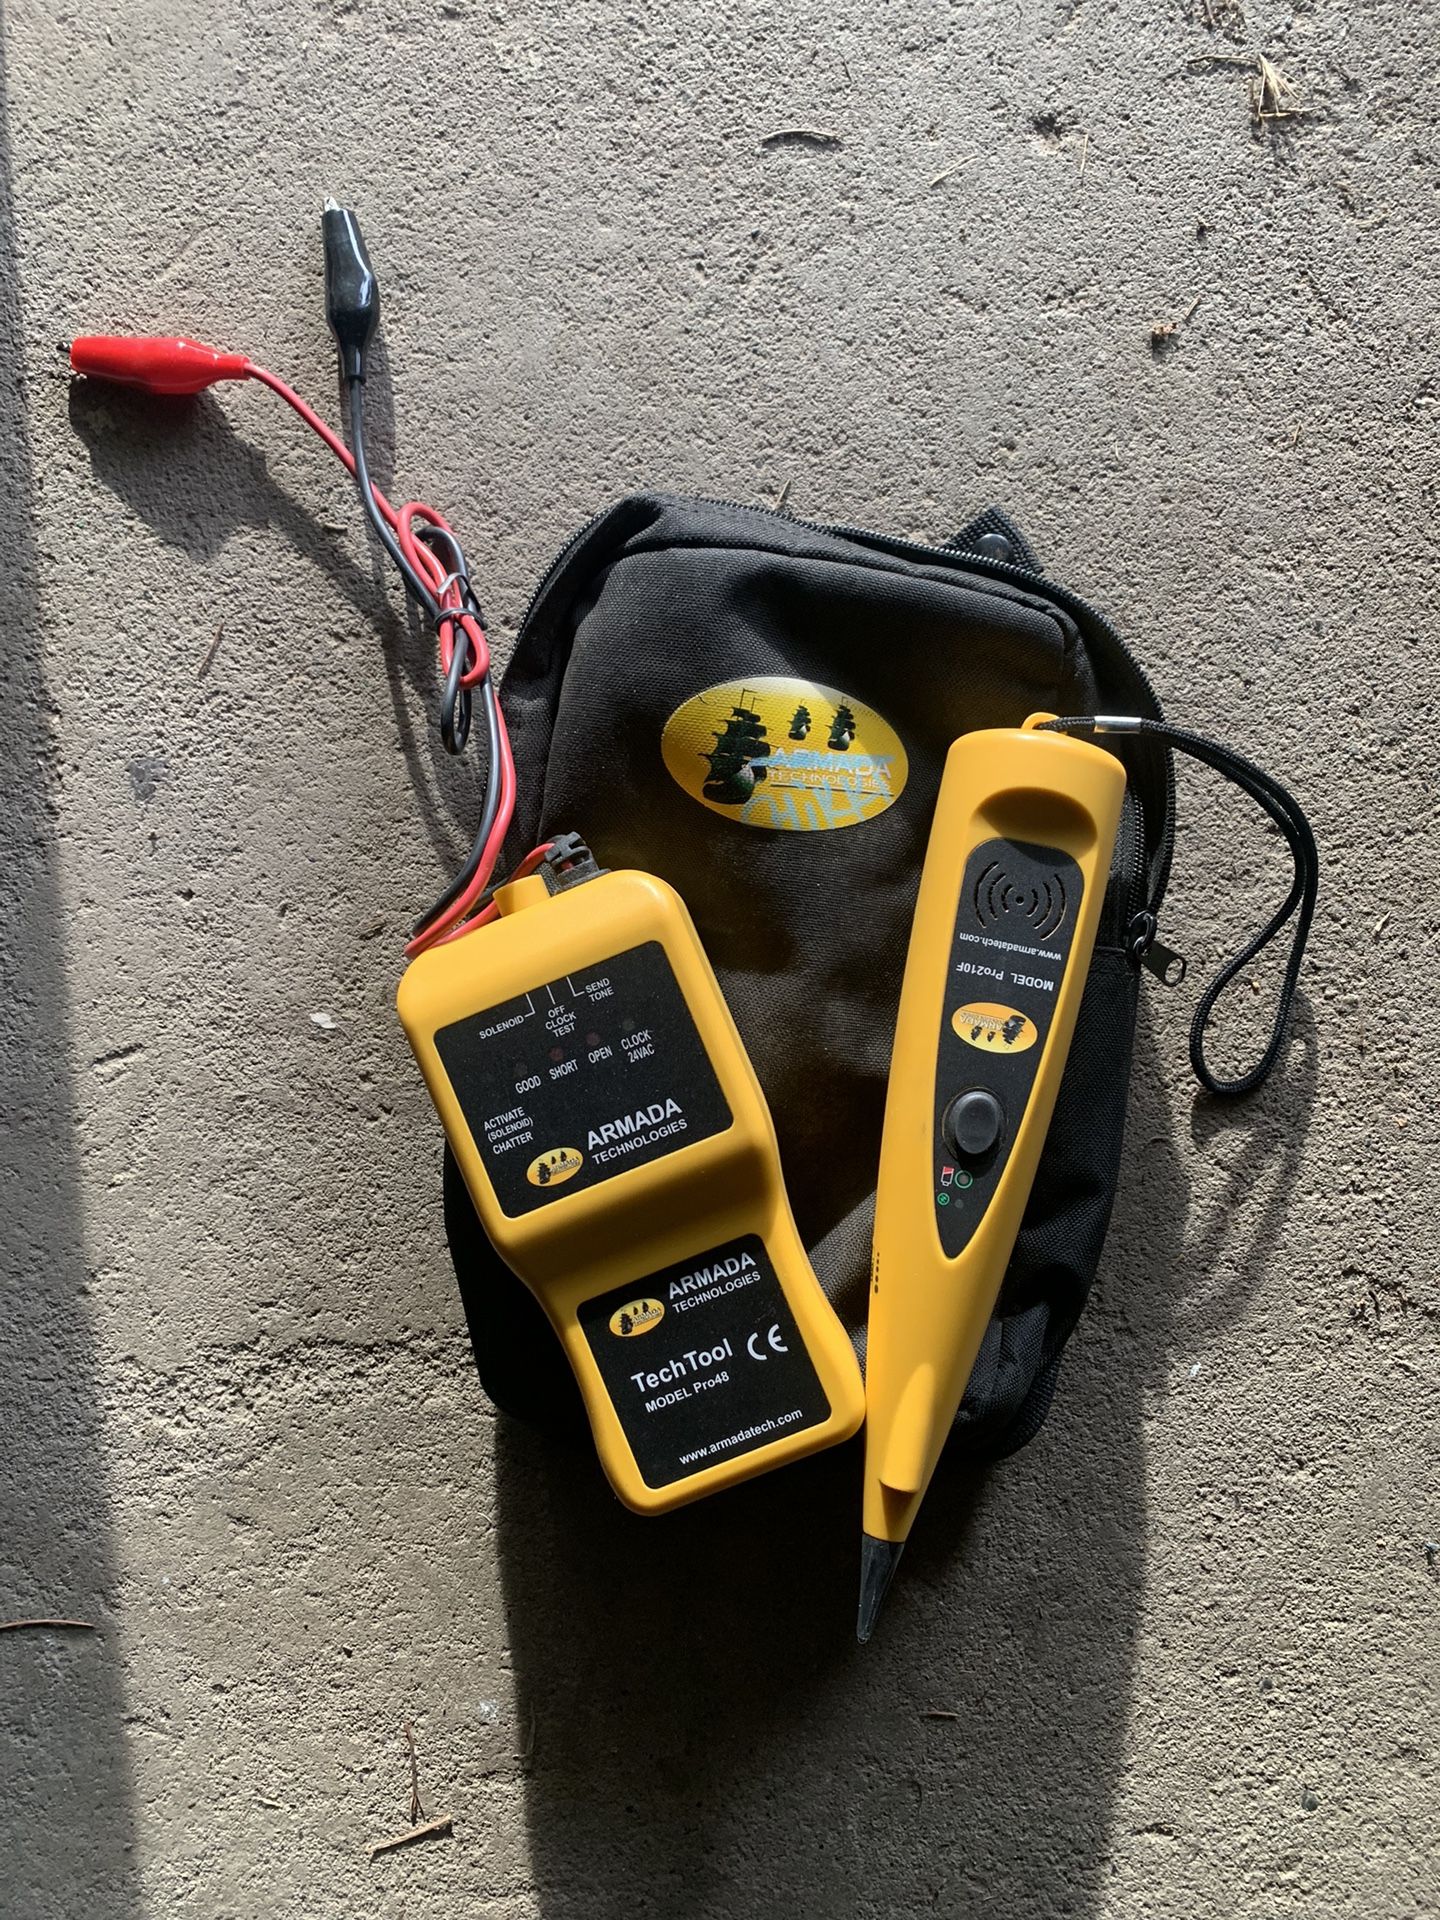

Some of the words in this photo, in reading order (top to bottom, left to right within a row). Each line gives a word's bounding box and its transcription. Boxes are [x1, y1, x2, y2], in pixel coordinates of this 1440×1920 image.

[959, 932, 1062, 960] www.armadatech.com
[956, 961, 1004, 980] Pro210F
[1010, 972, 1054, 991] MODEL
[585, 977, 611, 994] SEND
[588, 986, 615, 1002] TONE
[545, 1011, 577, 1030] CLOCK
[548, 1004, 566, 1018] OFF
[479, 1015, 524, 1040] SOLENOID
[552, 1022, 576, 1037] TEST
[515, 1075, 542, 1094] GOOD
[549, 1059, 579, 1081] SHORT
[588, 1045, 613, 1064] OPEN
[621, 1029, 652, 1050] CLOCK
[627, 1043, 655, 1063] 24VAC
[484, 1106, 525, 1131] ACTIVATE
[487, 1117, 534, 1143] (SOLENOID)
[587, 1098, 683, 1151] ARMADA
[492, 1131, 533, 1155] CHATTER
[592, 1118, 688, 1165] TECHNOLOGIES
[668, 1252, 757, 1299] ARMADA
[672, 1271, 761, 1314] TECHNOLOGIES
[630, 1337, 733, 1393] TechTool
[645, 1387, 692, 1413] MODEL
[693, 1371, 729, 1394] Pro48
[679, 1408, 803, 1465] www.armadatech.com
